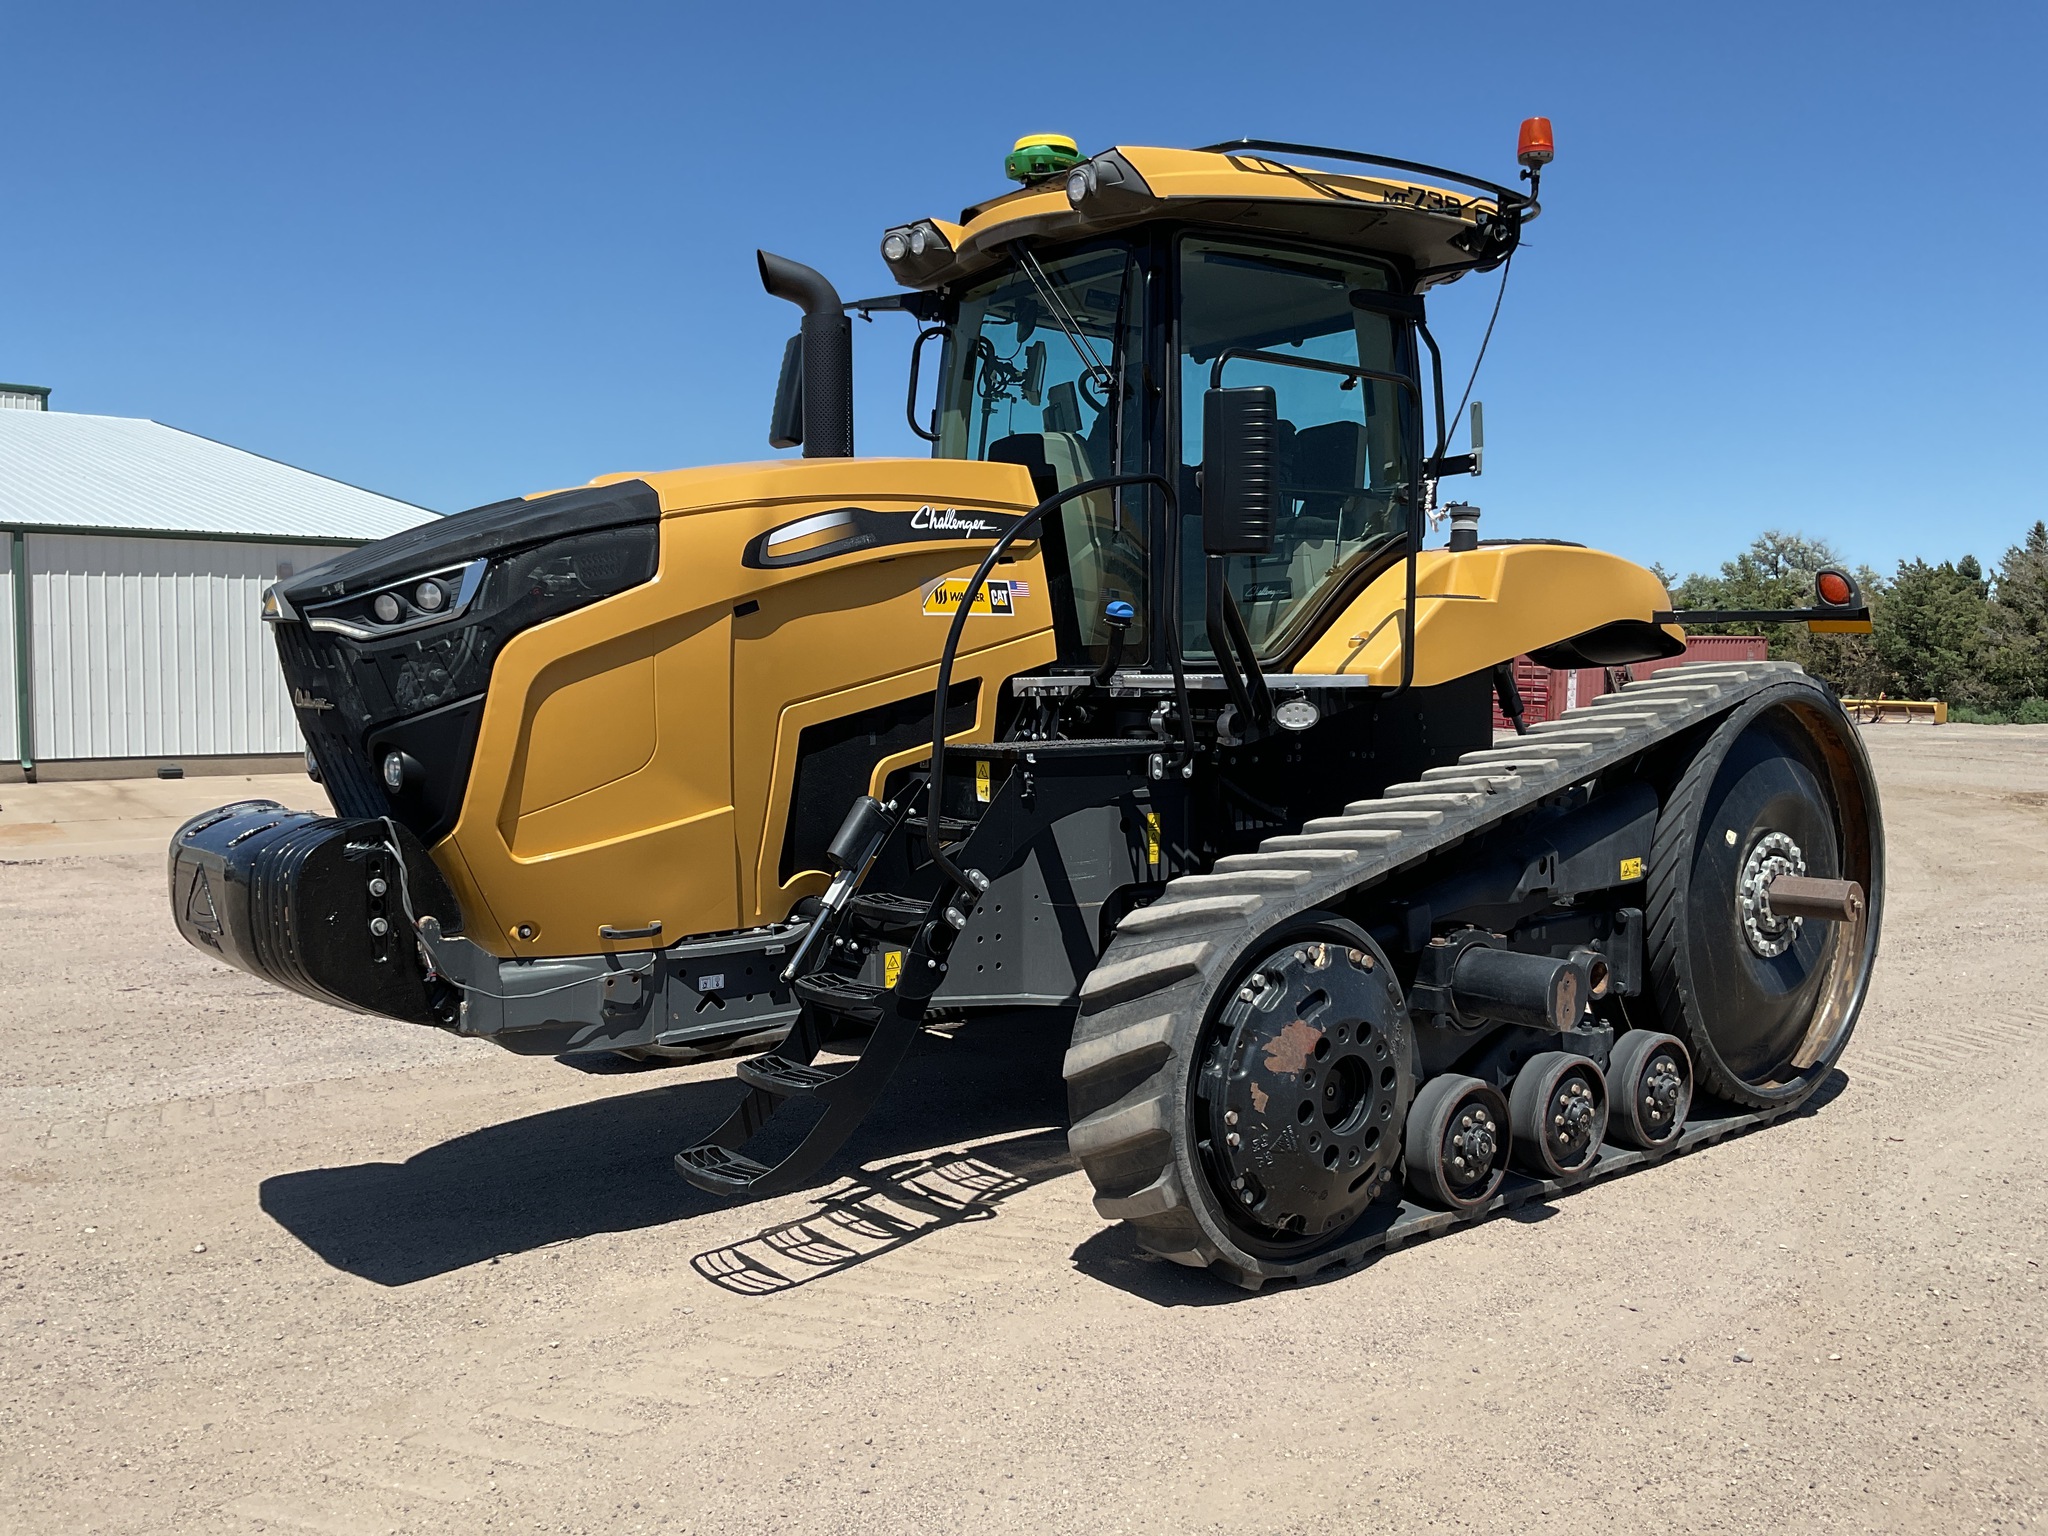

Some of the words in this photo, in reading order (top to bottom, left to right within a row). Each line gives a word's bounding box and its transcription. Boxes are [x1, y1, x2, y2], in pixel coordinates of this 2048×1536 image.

[910, 505, 1002, 538] Challenger
[950, 591, 985, 602] WAER
[990, 589, 1008, 606] CAT
